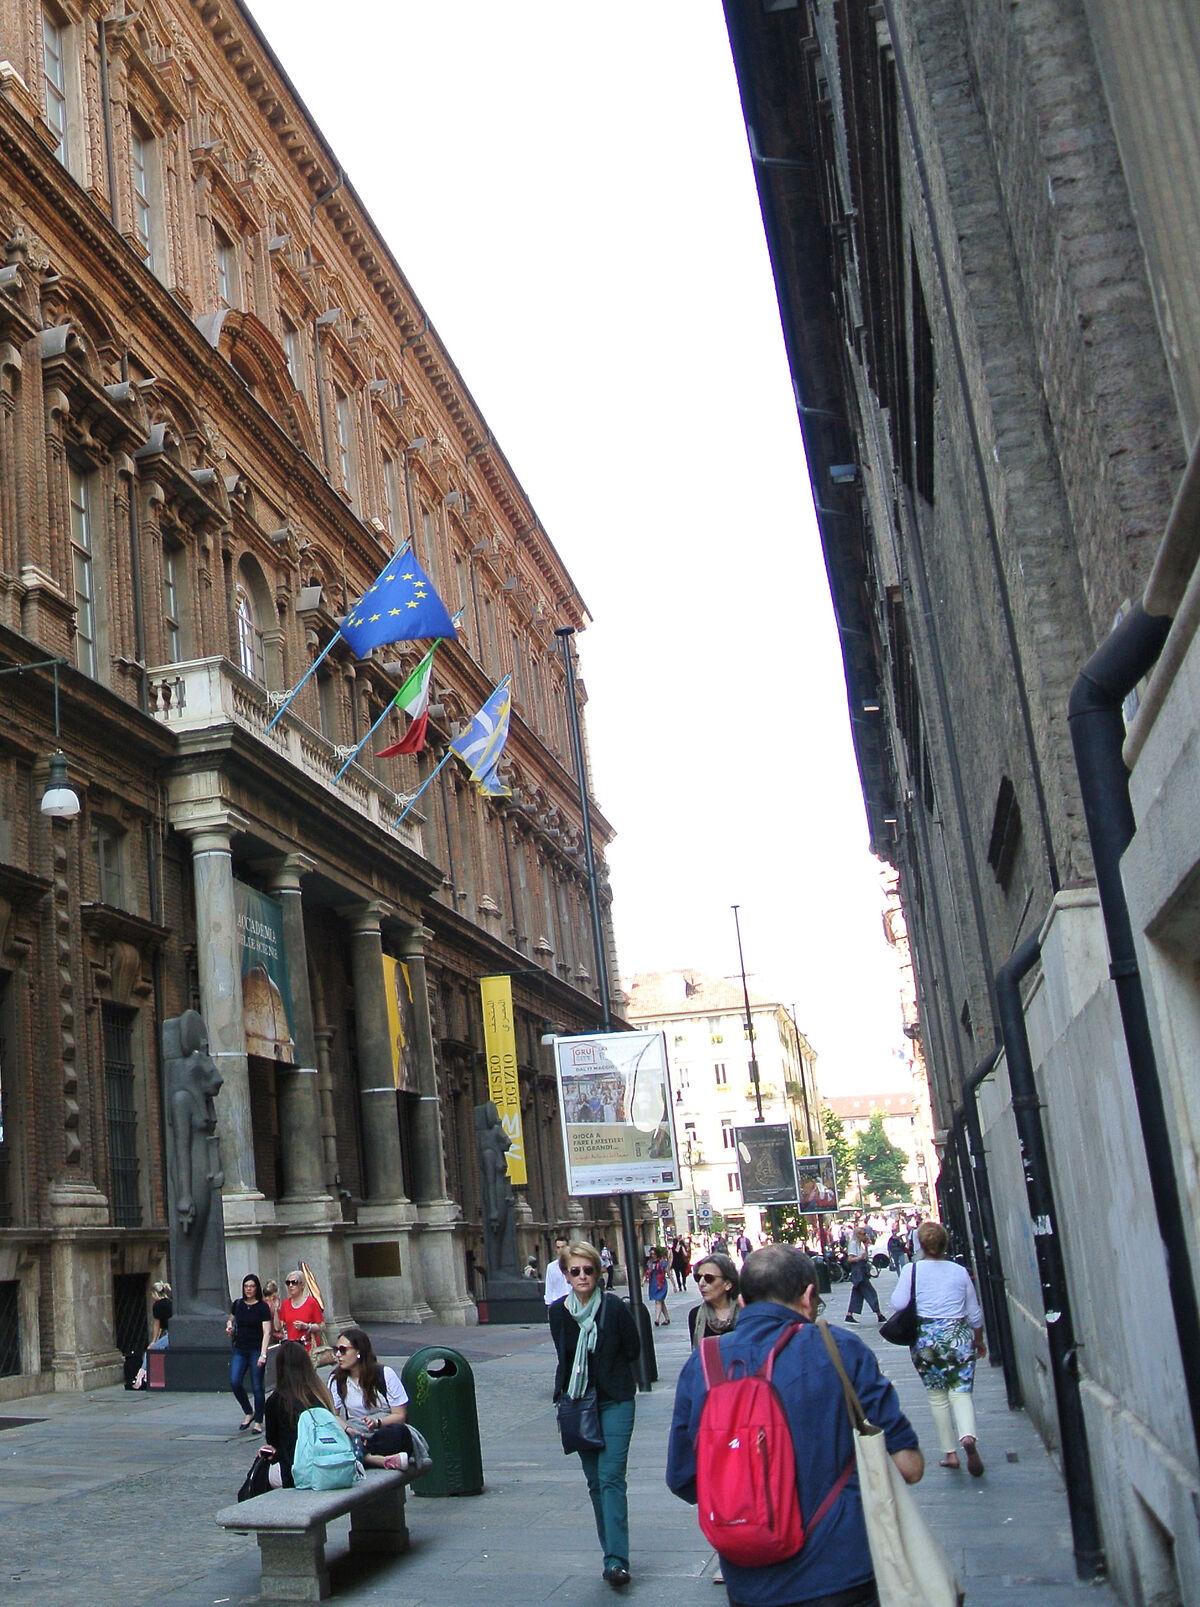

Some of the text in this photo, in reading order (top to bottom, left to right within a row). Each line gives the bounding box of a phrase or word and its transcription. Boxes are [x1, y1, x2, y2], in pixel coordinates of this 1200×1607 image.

[237, 913, 277, 944] ACCADEMIA
[490, 1054, 503, 1107] MUSEO
[503, 1053, 517, 1106] EGIZIO
